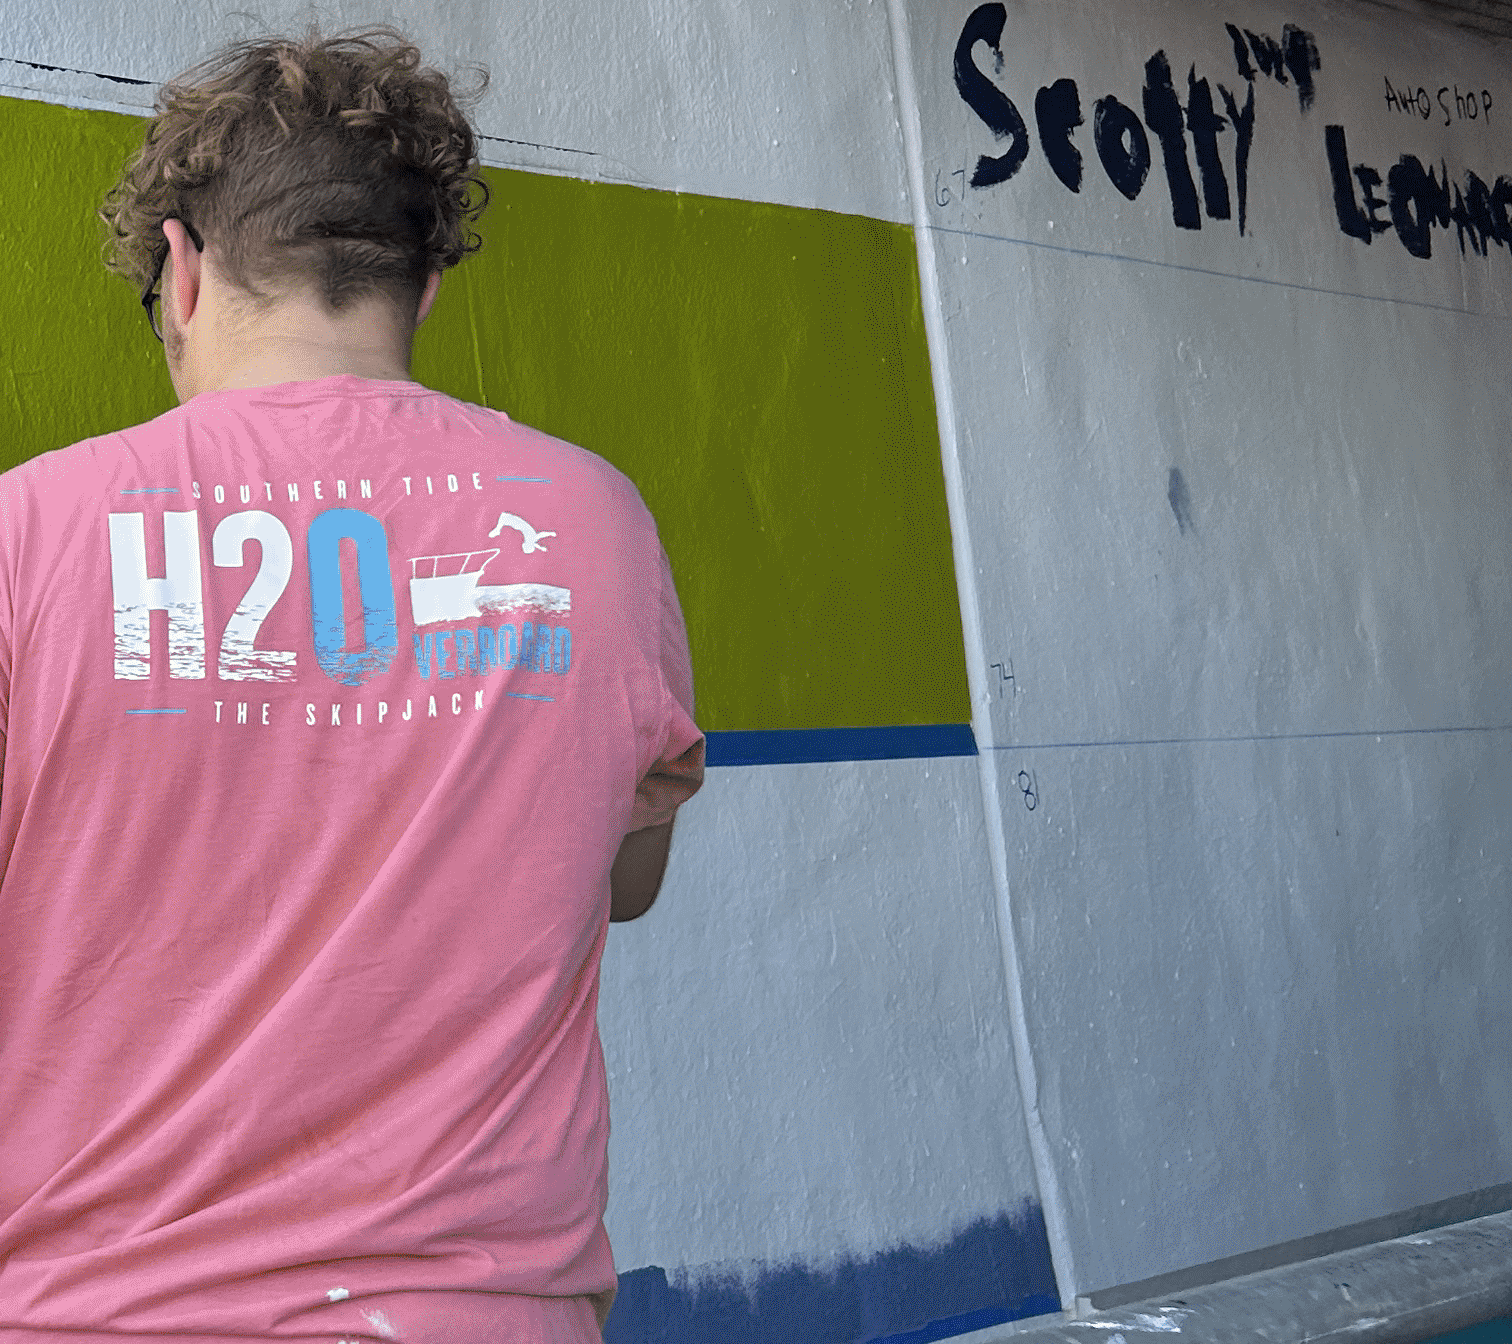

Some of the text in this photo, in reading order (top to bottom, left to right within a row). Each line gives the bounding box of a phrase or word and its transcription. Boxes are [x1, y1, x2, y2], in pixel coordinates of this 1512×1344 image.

[192, 471, 484, 504] SOUTHERN TIDE
[989, 657, 1017, 699] 74
[214, 689, 485, 726] THE SKIPJACK
